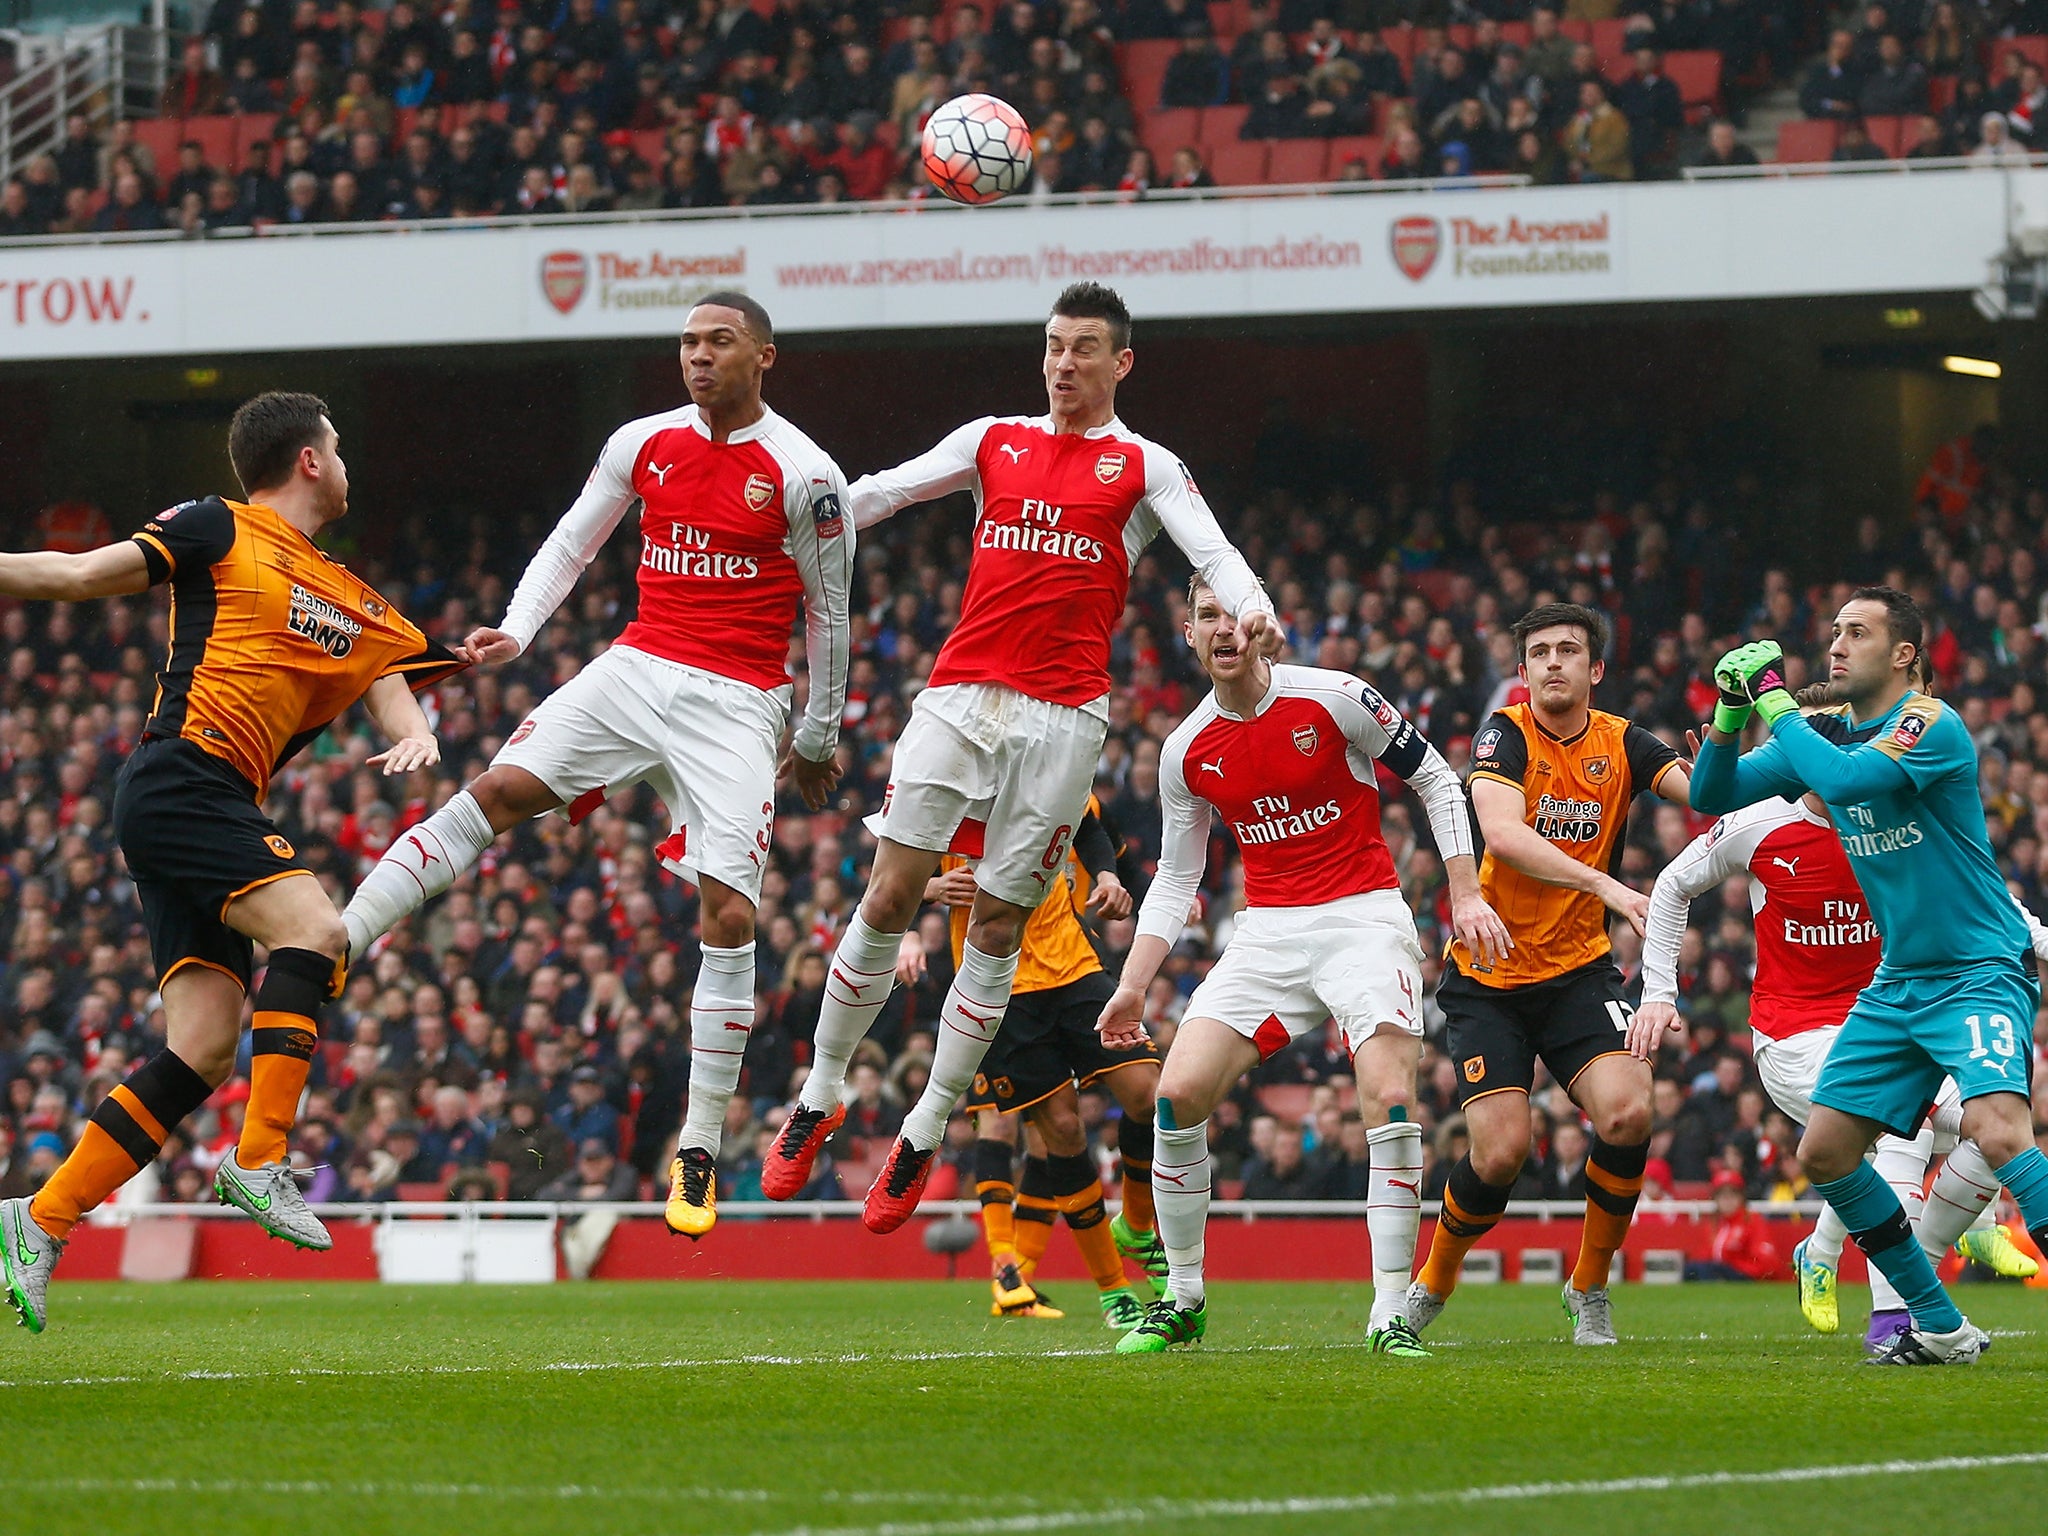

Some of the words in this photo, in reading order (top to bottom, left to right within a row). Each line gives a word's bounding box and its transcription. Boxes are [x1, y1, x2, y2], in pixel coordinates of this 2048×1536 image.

[1449, 217, 1498, 245] The
[1506, 211, 1608, 244] Arsenal
[597, 252, 640, 279] The
[650, 246, 746, 278] Arsenal
[1453, 250, 1609, 276] Foundation
[600, 280, 746, 309] Foundat
[1021, 498, 1062, 527] Fly
[671, 521, 710, 550] Fly
[980, 519, 1104, 564] Emirates
[640, 533, 759, 579] Emirates
[292, 583, 363, 636] flamingo
[288, 606, 352, 659] LAND
[1233, 799, 1342, 844] Emirates
[1252, 795, 1290, 816] Fly
[1846, 807, 1876, 828] Fly
[1535, 815, 1601, 843] LAND
[1837, 821, 1924, 857] mirates
[1823, 900, 1860, 920] Fly
[1396, 967, 1414, 1010] 4
[1964, 1013, 2016, 1059] 13
